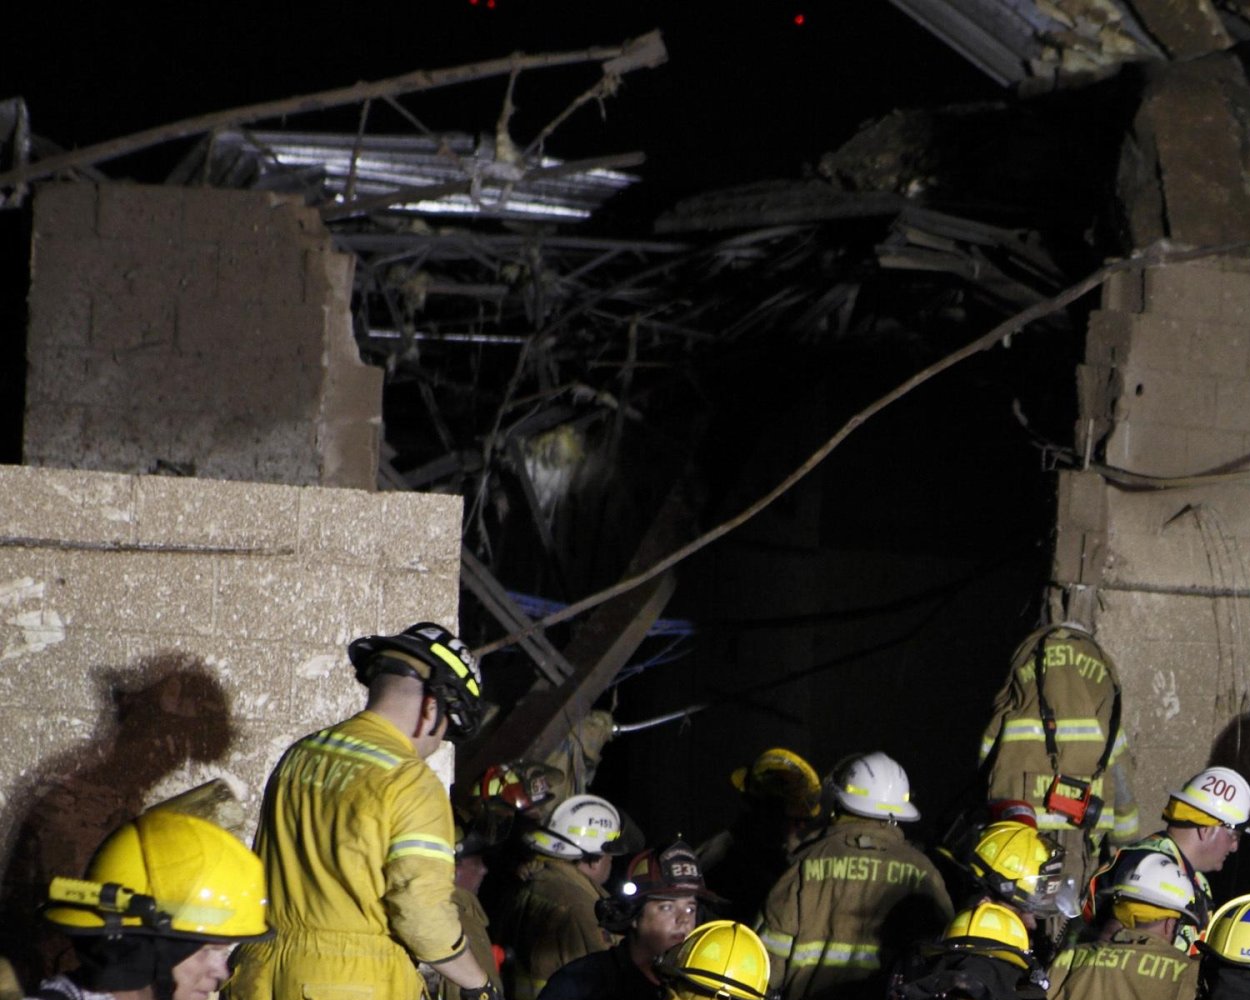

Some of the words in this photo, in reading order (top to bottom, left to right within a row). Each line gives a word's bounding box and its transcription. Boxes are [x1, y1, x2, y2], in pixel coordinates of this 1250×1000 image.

[1075, 653, 1107, 684] CITY
[1201, 775, 1237, 803] 200
[887, 861, 927, 888] CITY
[1137, 953, 1188, 983] CITY
